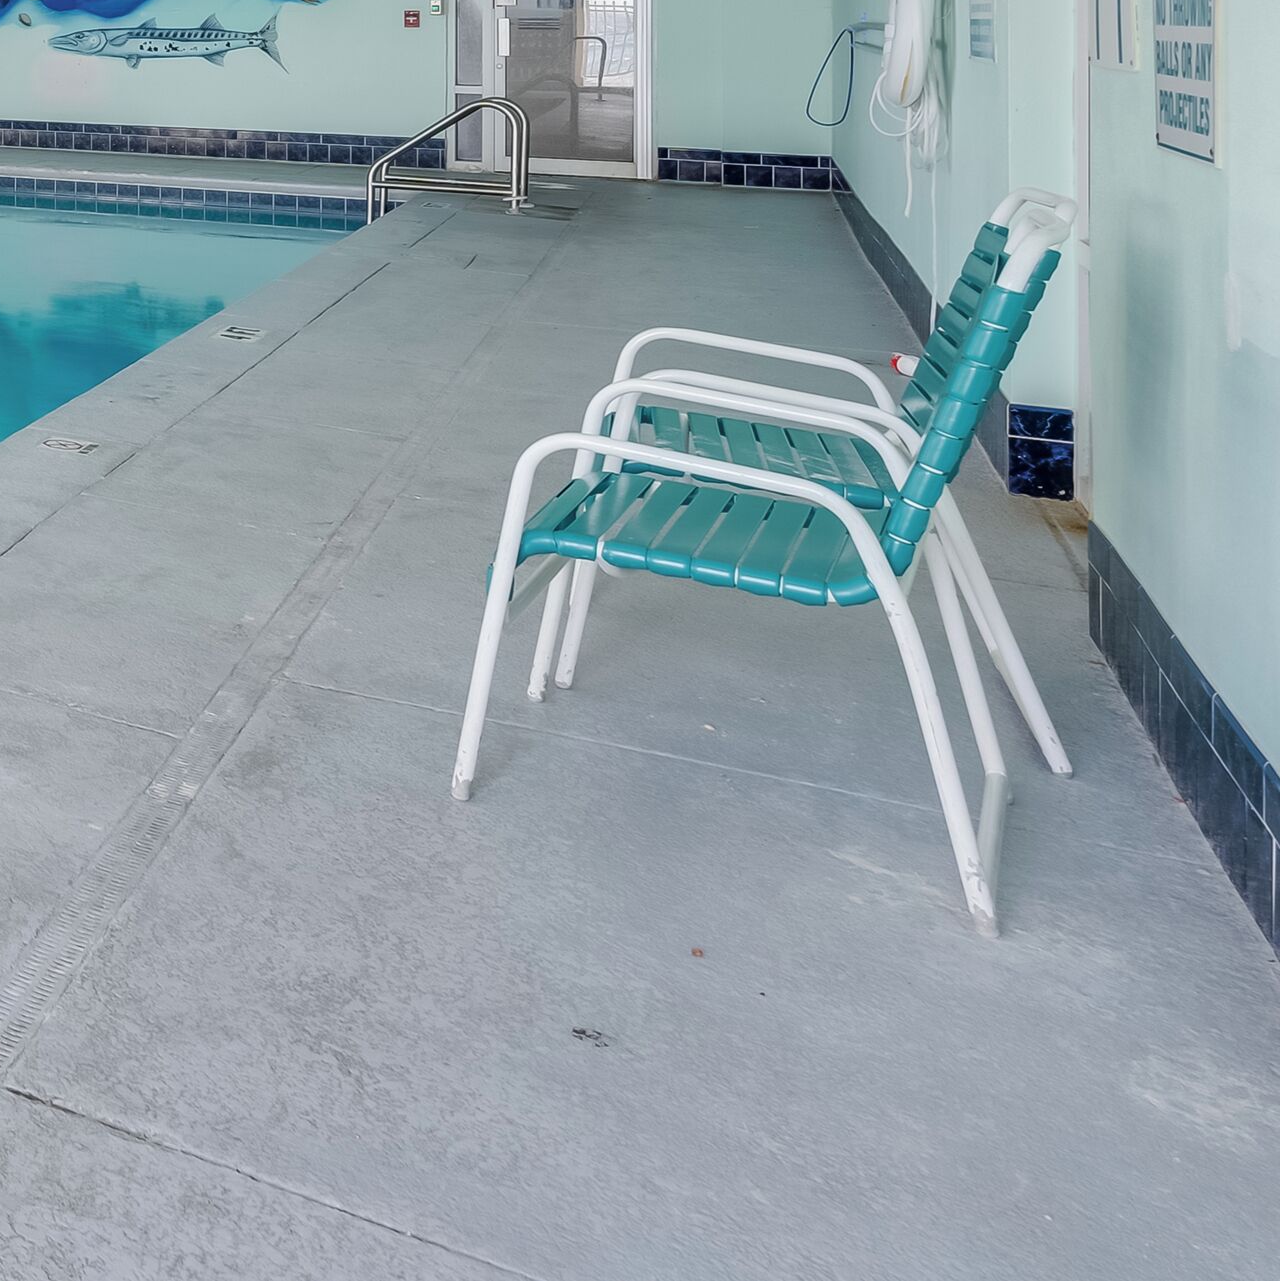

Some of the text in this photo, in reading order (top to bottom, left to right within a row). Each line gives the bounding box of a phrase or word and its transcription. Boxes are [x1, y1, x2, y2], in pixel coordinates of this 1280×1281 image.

[1156, 40, 1212, 82] BALLS OR ANY
[1159, 89, 1210, 136] PROJECTILES
